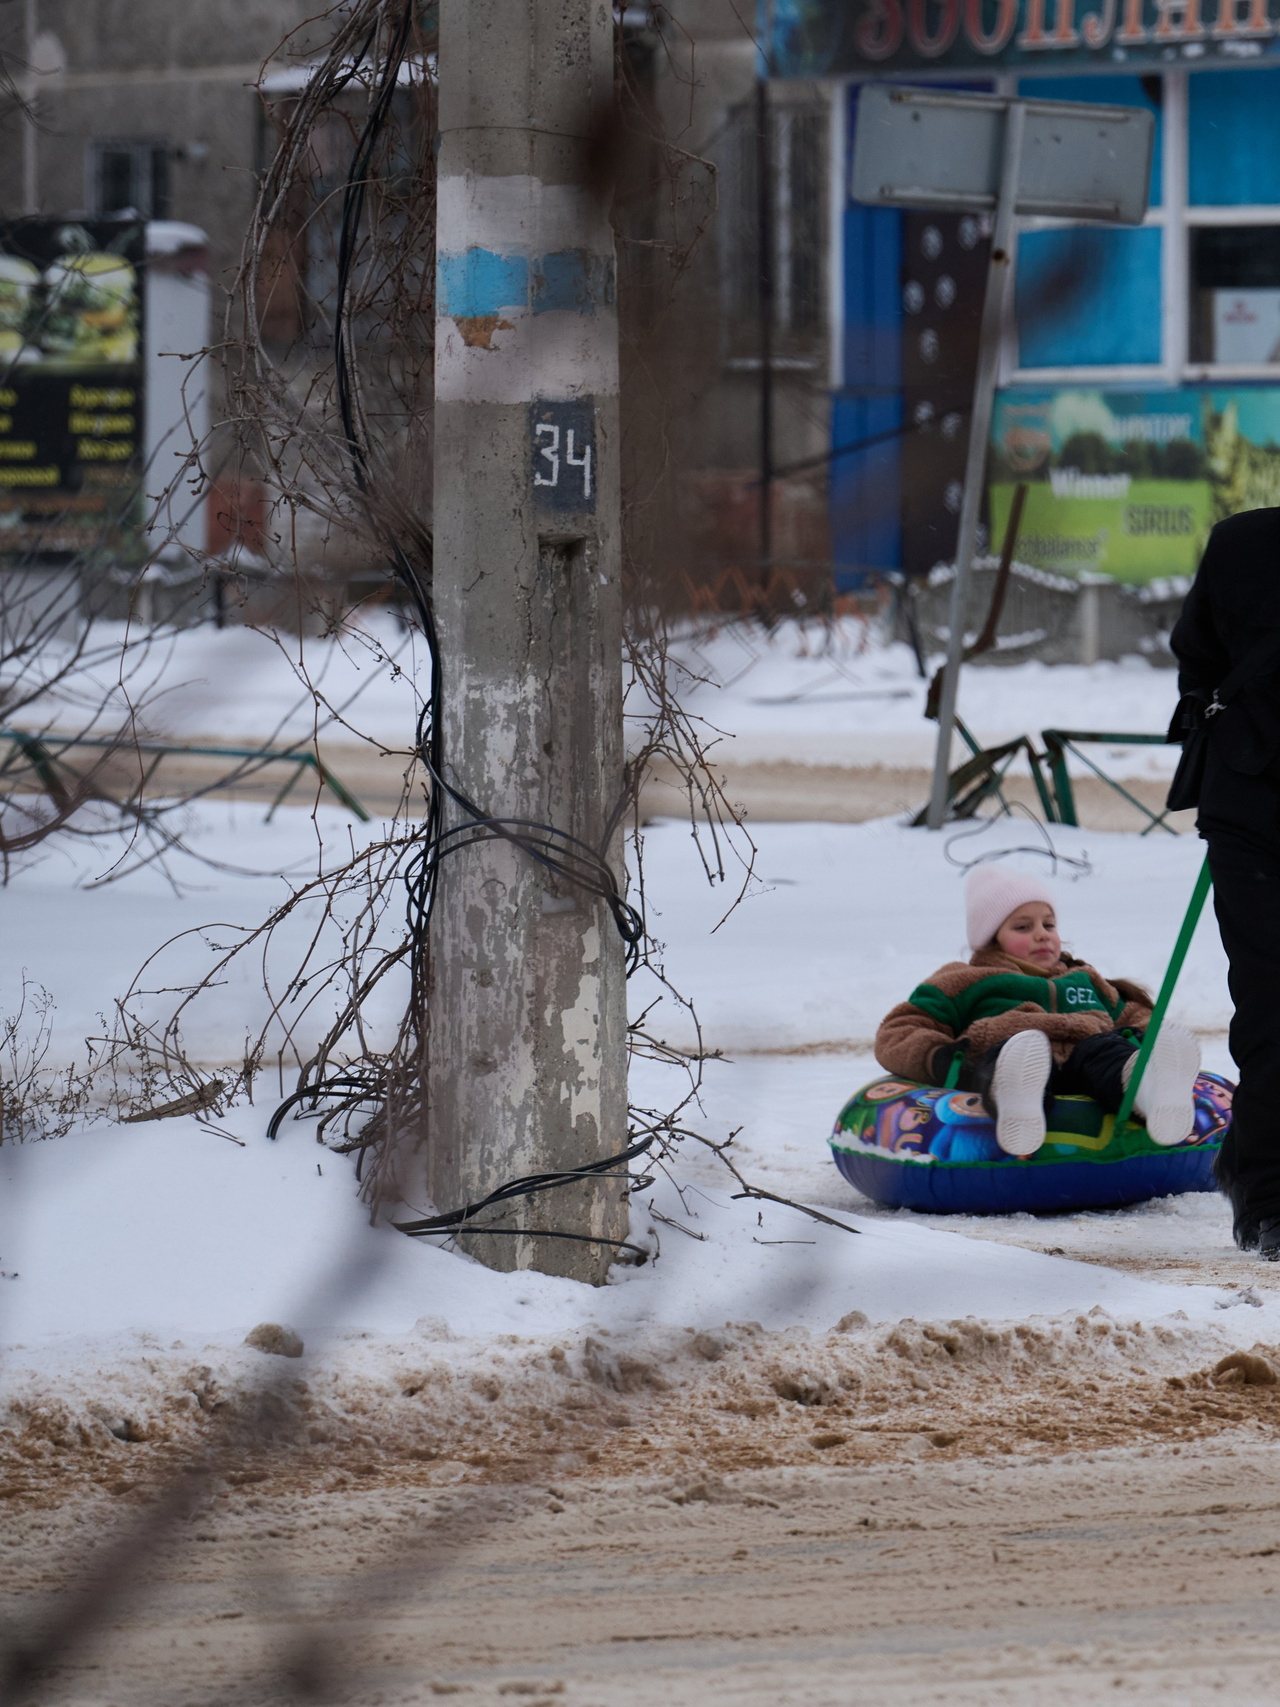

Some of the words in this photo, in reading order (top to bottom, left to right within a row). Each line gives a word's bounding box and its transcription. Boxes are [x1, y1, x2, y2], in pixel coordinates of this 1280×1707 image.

[534, 423, 592, 500] 34
[1049, 467, 1131, 499] Winner
[1126, 504, 1193, 536] SIRIUS
[1066, 987, 1096, 1004] GEZ
